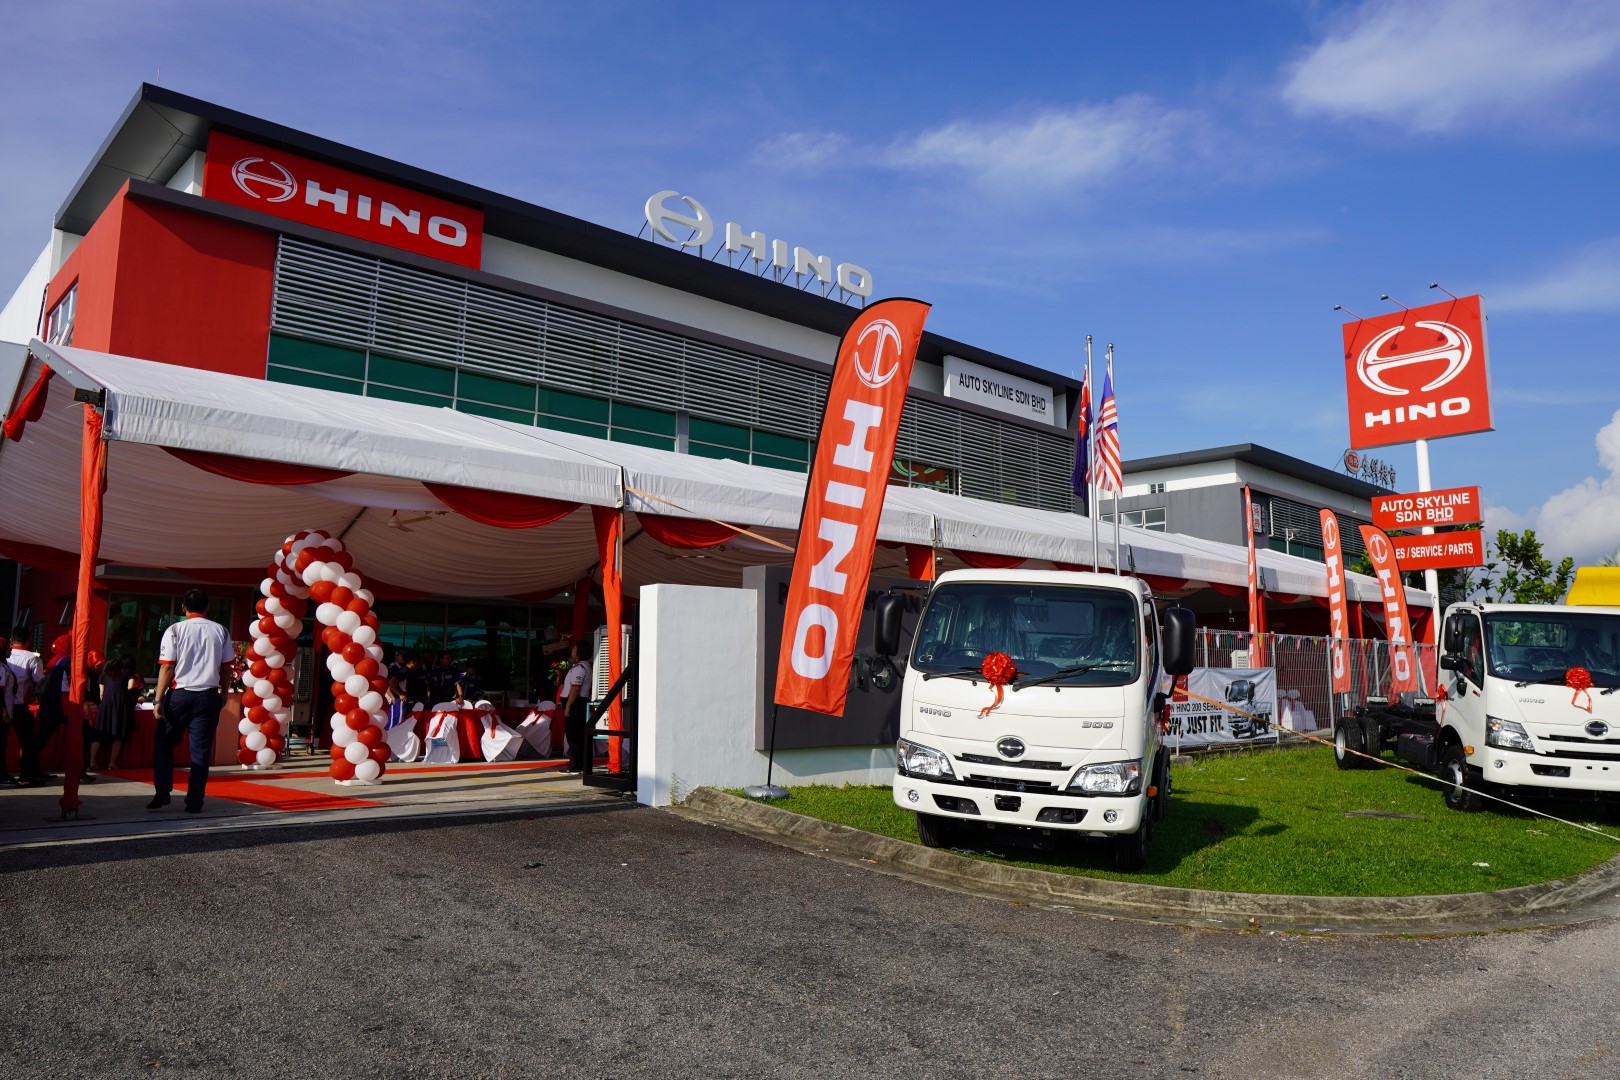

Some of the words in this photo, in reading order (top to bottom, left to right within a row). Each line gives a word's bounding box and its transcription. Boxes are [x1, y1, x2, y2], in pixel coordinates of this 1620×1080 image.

[305, 180, 467, 247] HINO
[726, 222, 872, 297] HINO
[959, 372, 980, 391] AUTO
[982, 379, 1013, 402] SKYLINE
[1015, 389, 1030, 406] SDN
[1032, 394, 1046, 411] BHD
[1365, 397, 1470, 427] HINO
[1380, 499, 1413, 513] AUTO
[1416, 493, 1470, 508] SKYLINE
[1395, 510, 1422, 523] SDN
[1426, 507, 1454, 520] BHD
[791, 399, 883, 680] HINO
[1395, 548, 1405, 560] ES
[1411, 545, 1442, 558] SERVICE
[1448, 542, 1473, 555] PARTS
[1327, 555, 1345, 679] HINO
[1378, 569, 1410, 681] HINO
[919, 706, 952, 718] HINO
[1176, 702, 1191, 713] HINO
[1082, 720, 1114, 729] 300
[1187, 716, 1207, 734] JUST
[1210, 714, 1224, 733] FIT.
